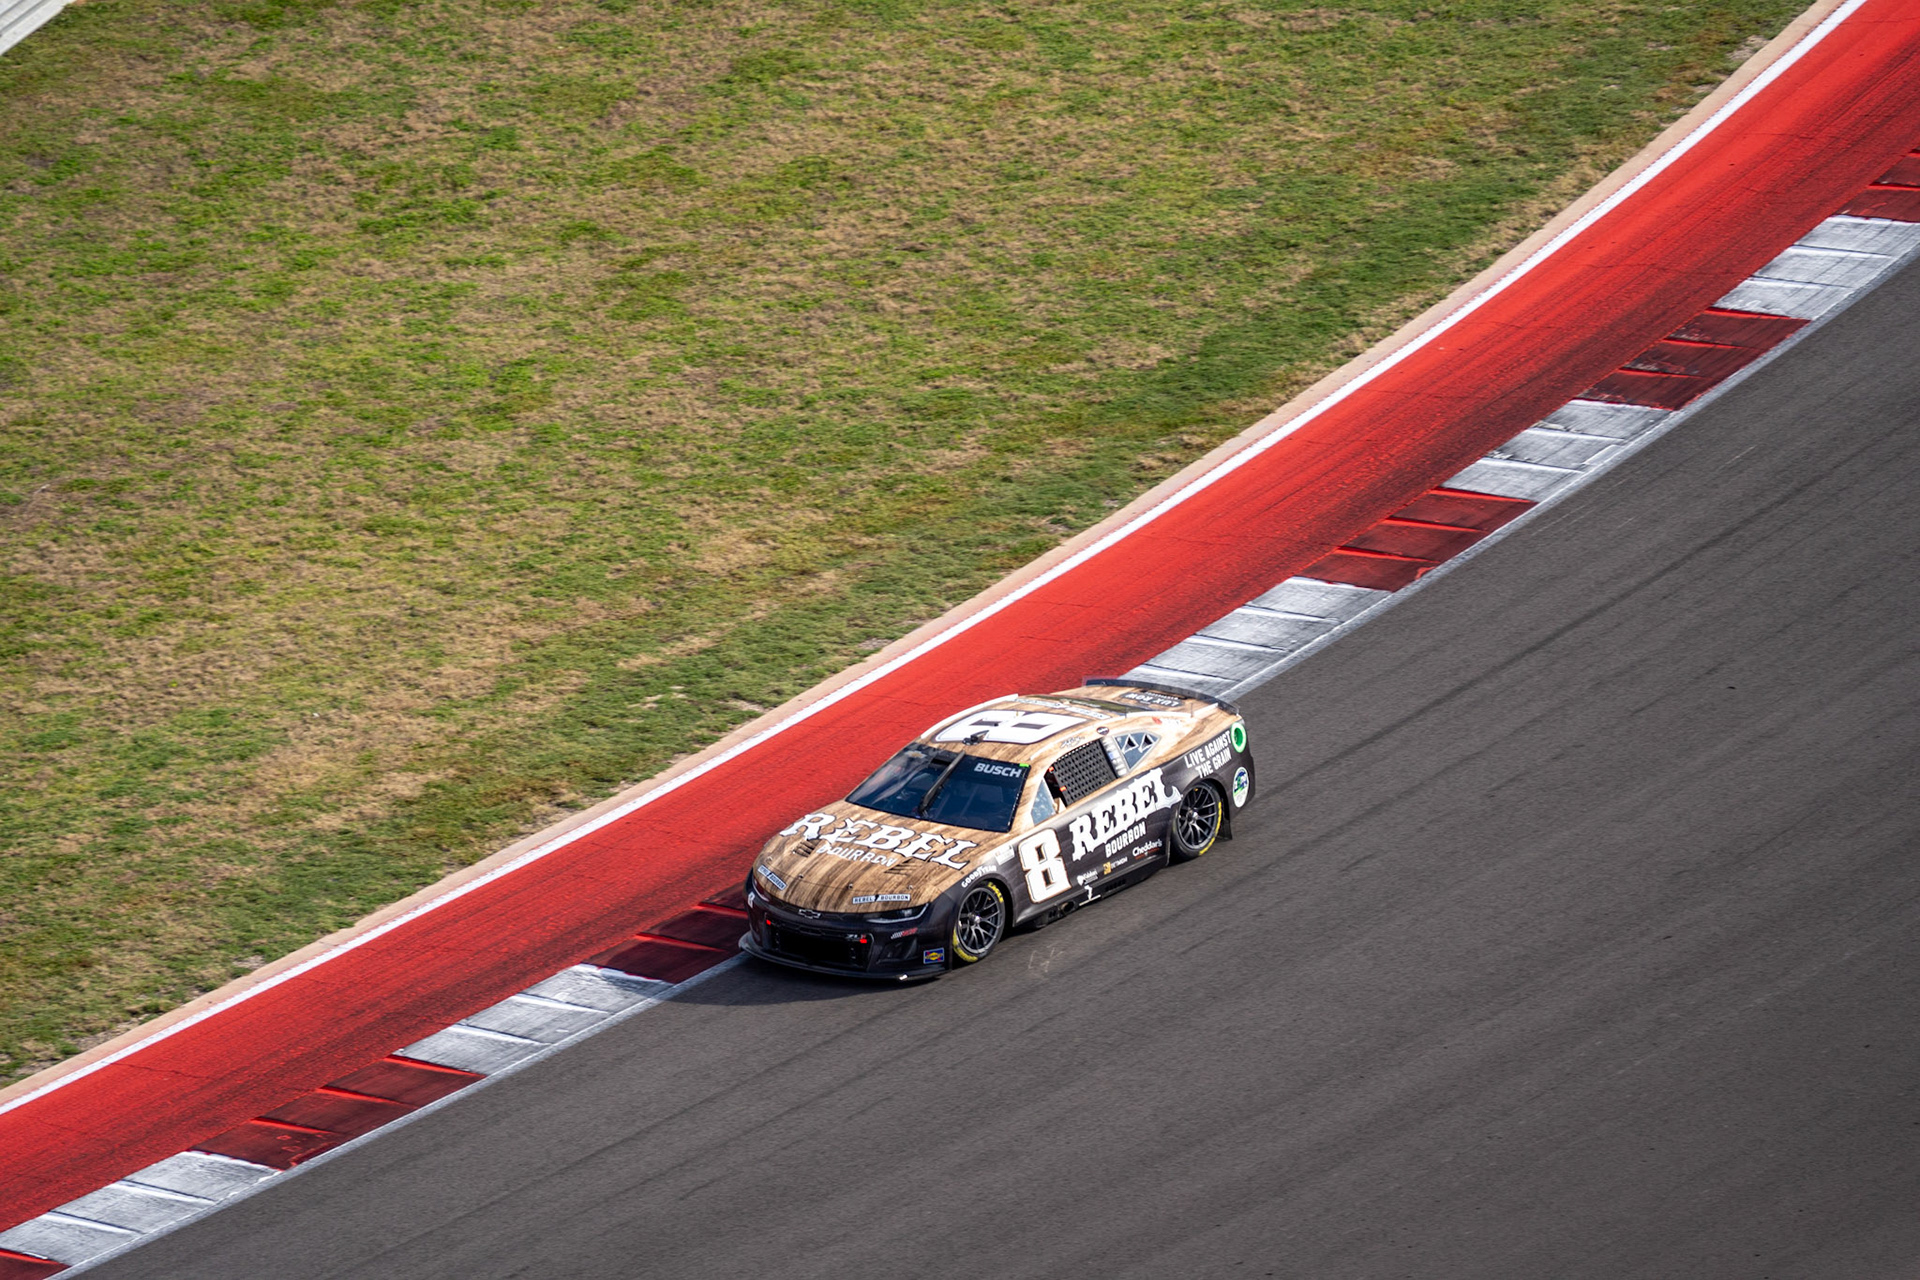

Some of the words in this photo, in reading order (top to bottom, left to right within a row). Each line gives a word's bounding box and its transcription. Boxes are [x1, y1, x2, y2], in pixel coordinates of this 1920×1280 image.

[1125, 693, 1153, 702] ROW
[1153, 698, 1179, 707] LUX
[935, 710, 1089, 744] 8
[1184, 748, 1206, 769] LIVE
[1204, 730, 1232, 759] AGAINST
[1195, 760, 1214, 779] THE
[1212, 747, 1232, 770] GRAIN
[974, 762, 1022, 778] BUSCH
[1069, 767, 1184, 862] REBEL
[779, 812, 979, 870] REBEL
[816, 843, 899, 868] BOURBON
[1105, 821, 1147, 858] BOURBON
[1132, 839, 1163, 857] Cheddar's
[961, 865, 998, 888] GOODYEAR
[1018, 828, 1072, 904] 8
